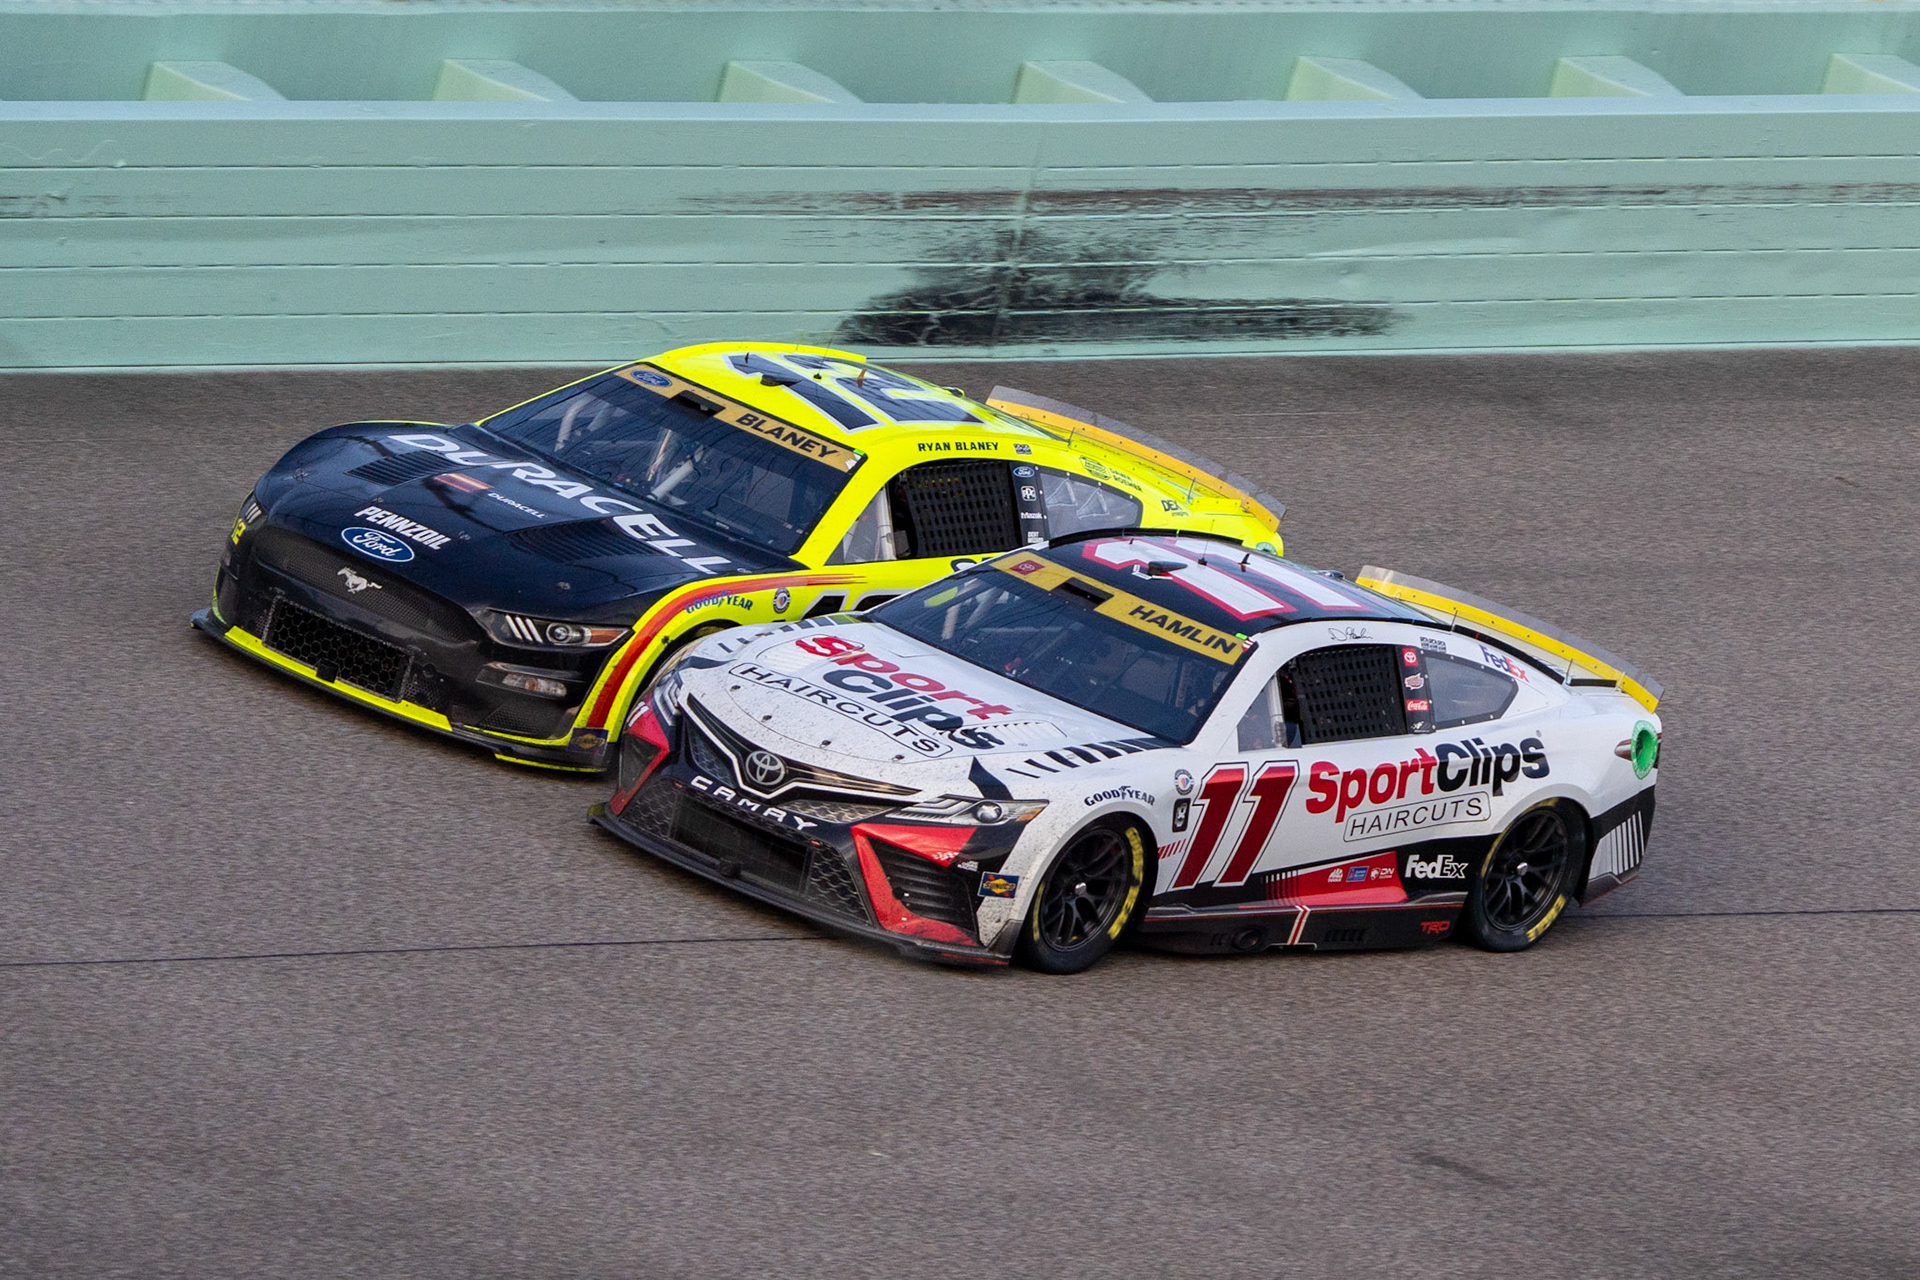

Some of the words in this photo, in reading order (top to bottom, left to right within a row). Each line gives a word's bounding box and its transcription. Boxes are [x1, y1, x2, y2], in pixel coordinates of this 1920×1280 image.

[723, 352, 986, 433] 12
[736, 413, 839, 458] BLANEY
[918, 443, 951, 451] RYAN
[955, 442, 998, 451] BLANEY
[388, 434, 731, 574] DURACELL
[488, 492, 546, 518] DURACELL
[354, 506, 451, 549] PENNZOIL
[685, 591, 753, 612] GOODYEAR
[1128, 605, 1237, 654] HAMLIN
[795, 636, 1013, 720] Sport
[1479, 644, 1530, 683] FedEx
[740, 667, 940, 752] HAIRCUTS
[823, 669, 1005, 750] Clips
[691, 775, 818, 830] CAMRY
[1084, 786, 1155, 806] GOODYEAR
[1350, 798, 1483, 836] HAIRCUTS
[1168, 761, 1299, 890] 11
[1405, 854, 1468, 878] FedEx
[1421, 921, 1450, 935] TRD
